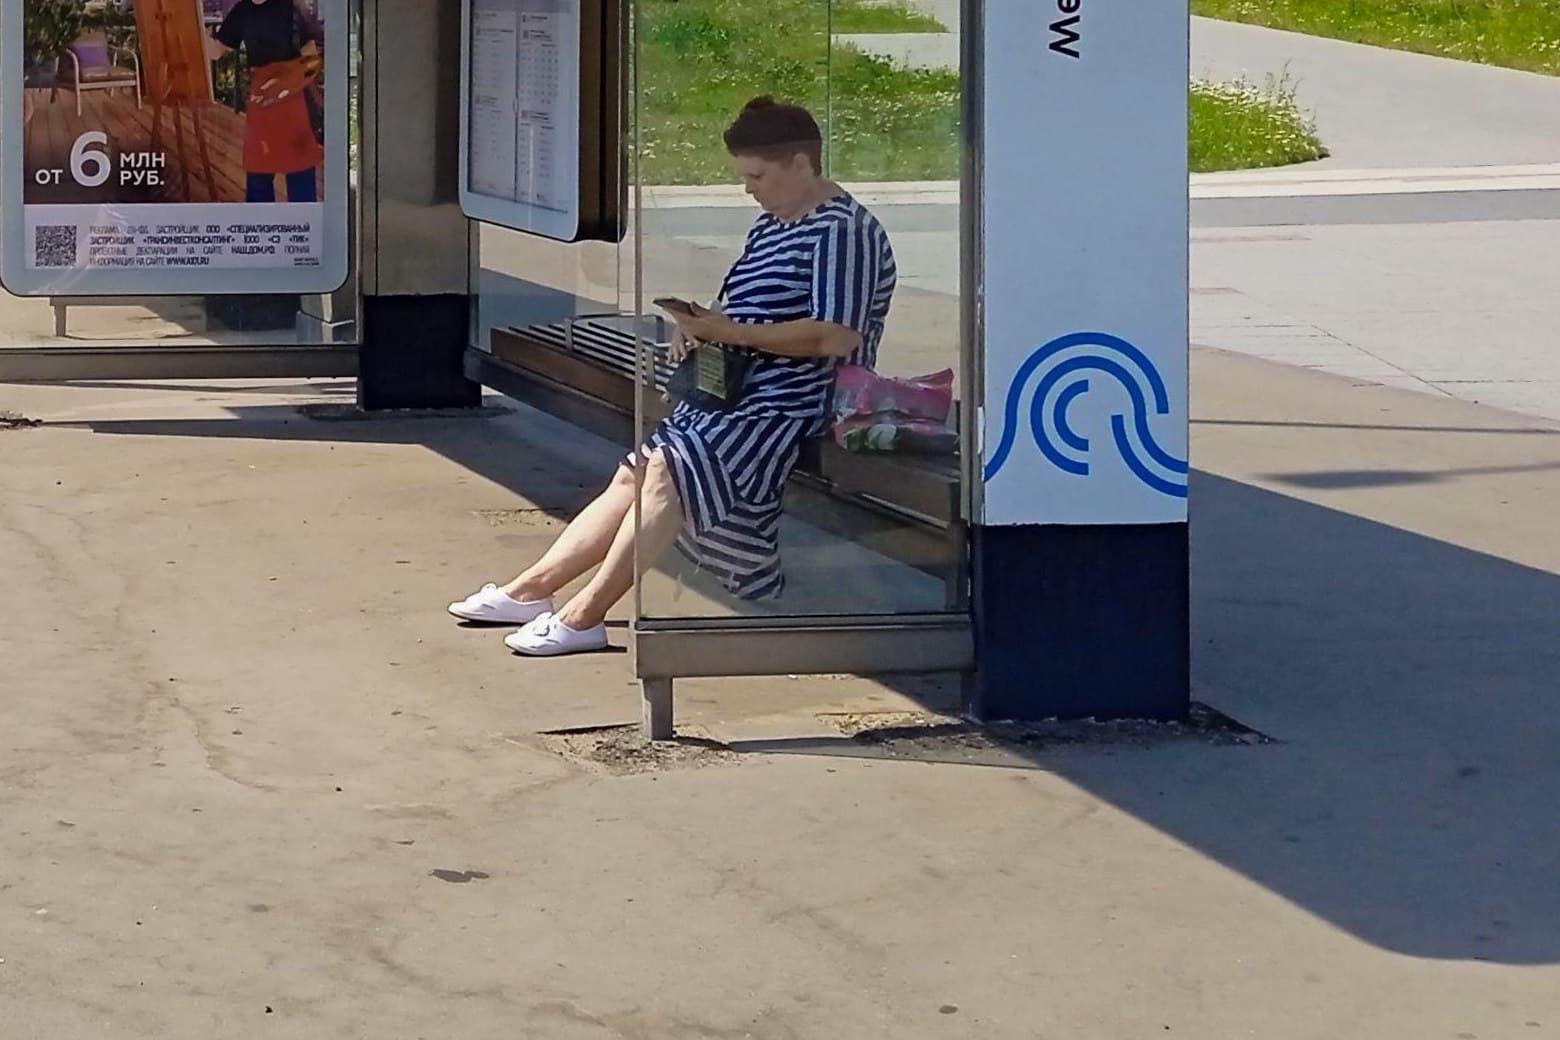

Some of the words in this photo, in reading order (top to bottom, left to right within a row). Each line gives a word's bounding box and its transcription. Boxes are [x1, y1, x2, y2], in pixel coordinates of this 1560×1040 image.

[35, 169, 63, 185] ОТ
[70, 130, 111, 187] 6
[120, 152, 165, 168] МЛН
[120, 170, 165, 186] РУБ.
